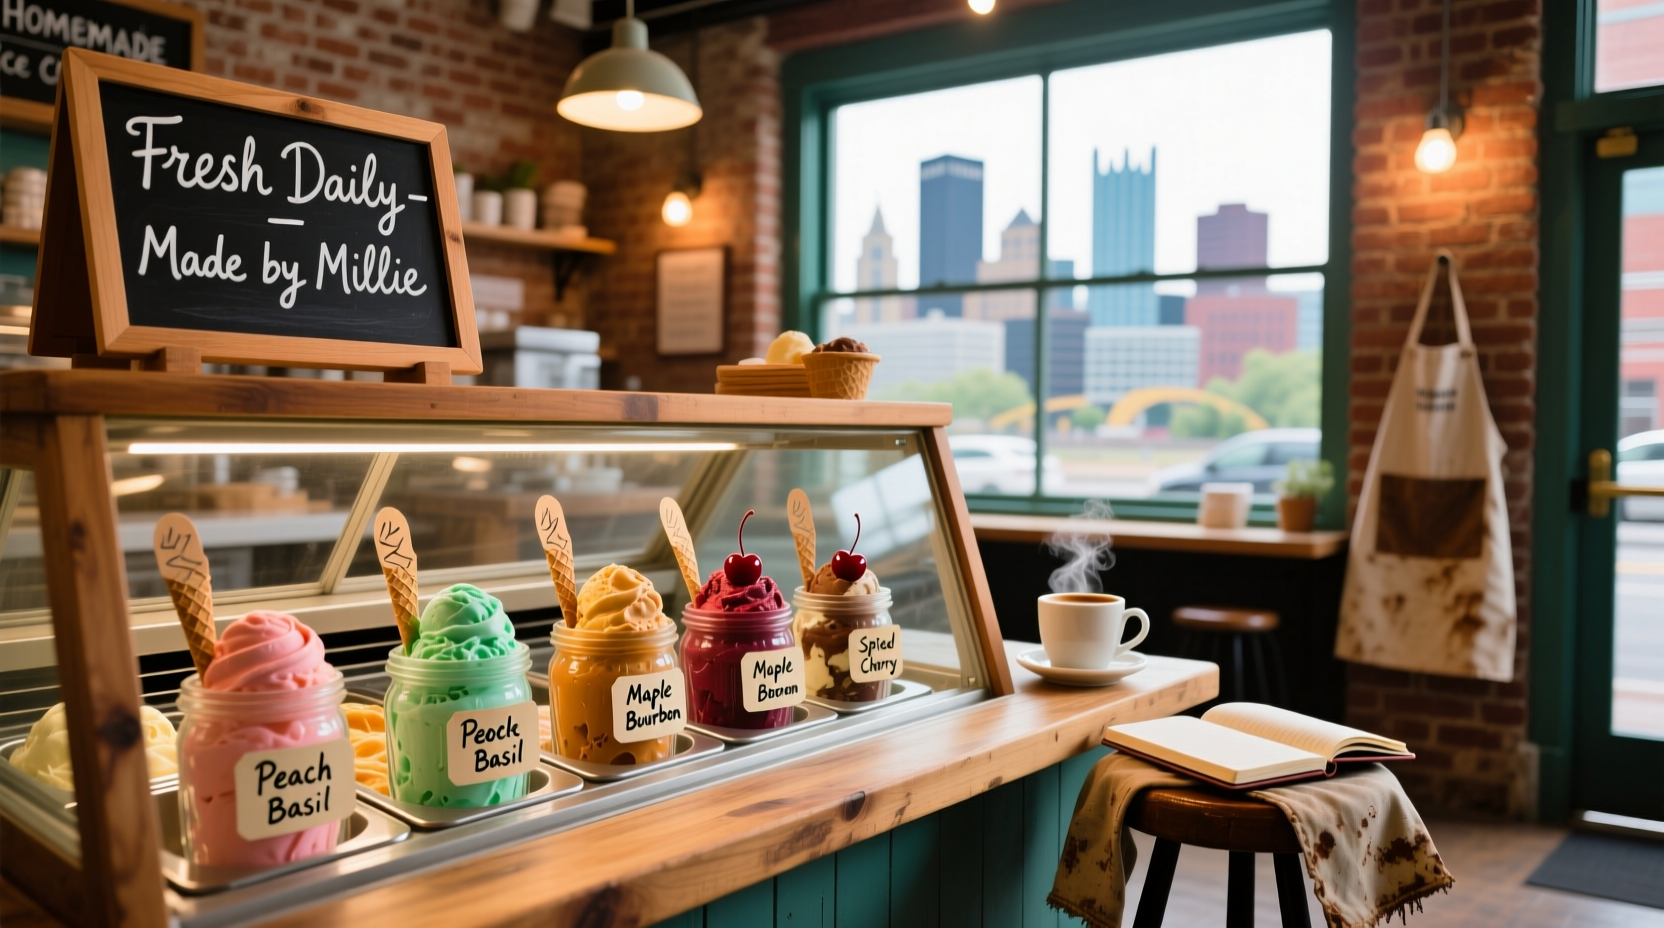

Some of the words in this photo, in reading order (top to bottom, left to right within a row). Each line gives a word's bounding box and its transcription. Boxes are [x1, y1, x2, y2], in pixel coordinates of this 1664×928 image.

[2, 0, 168, 66] HOMEMADE
[125, 115, 273, 196] Fresh
[137, 224, 247, 282] Made
[262, 240, 307, 309] by
[315, 241, 427, 297] Millie
[626, 678, 673, 710] Maple
[254, 751, 332, 797] Peach
[474, 738, 524, 773] Basil
[267, 785, 331, 826] Basil
